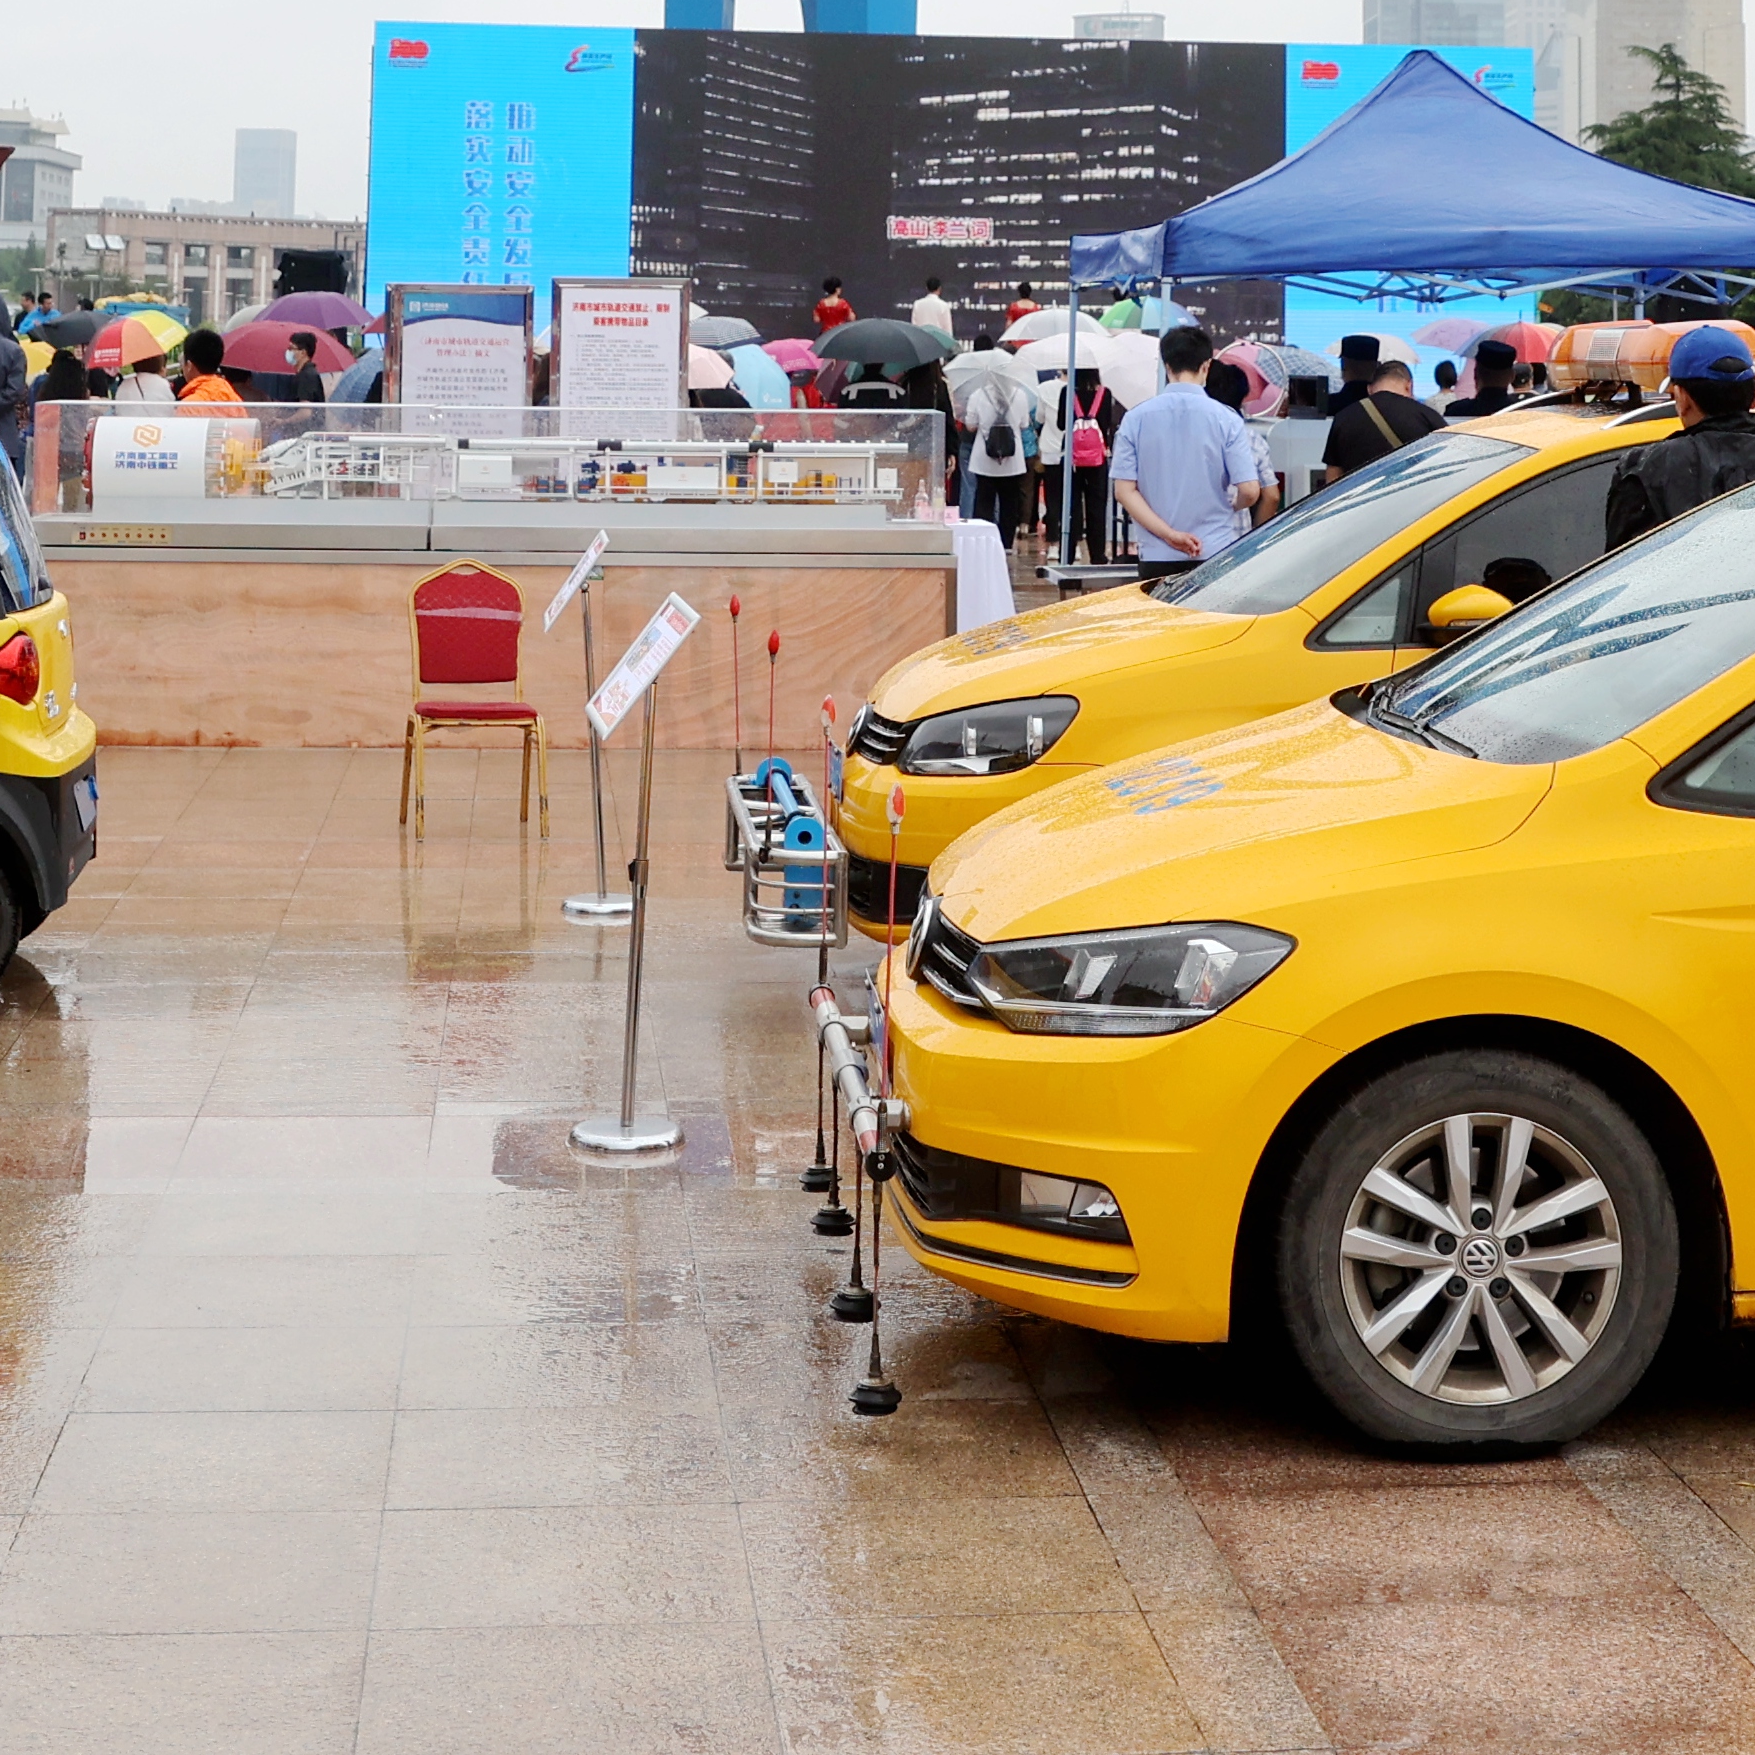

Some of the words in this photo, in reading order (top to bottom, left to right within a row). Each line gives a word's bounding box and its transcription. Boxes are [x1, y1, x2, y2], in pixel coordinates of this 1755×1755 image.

[893, 219, 926, 237] 高山
[115, 461, 178, 469] 济南中铁重工
